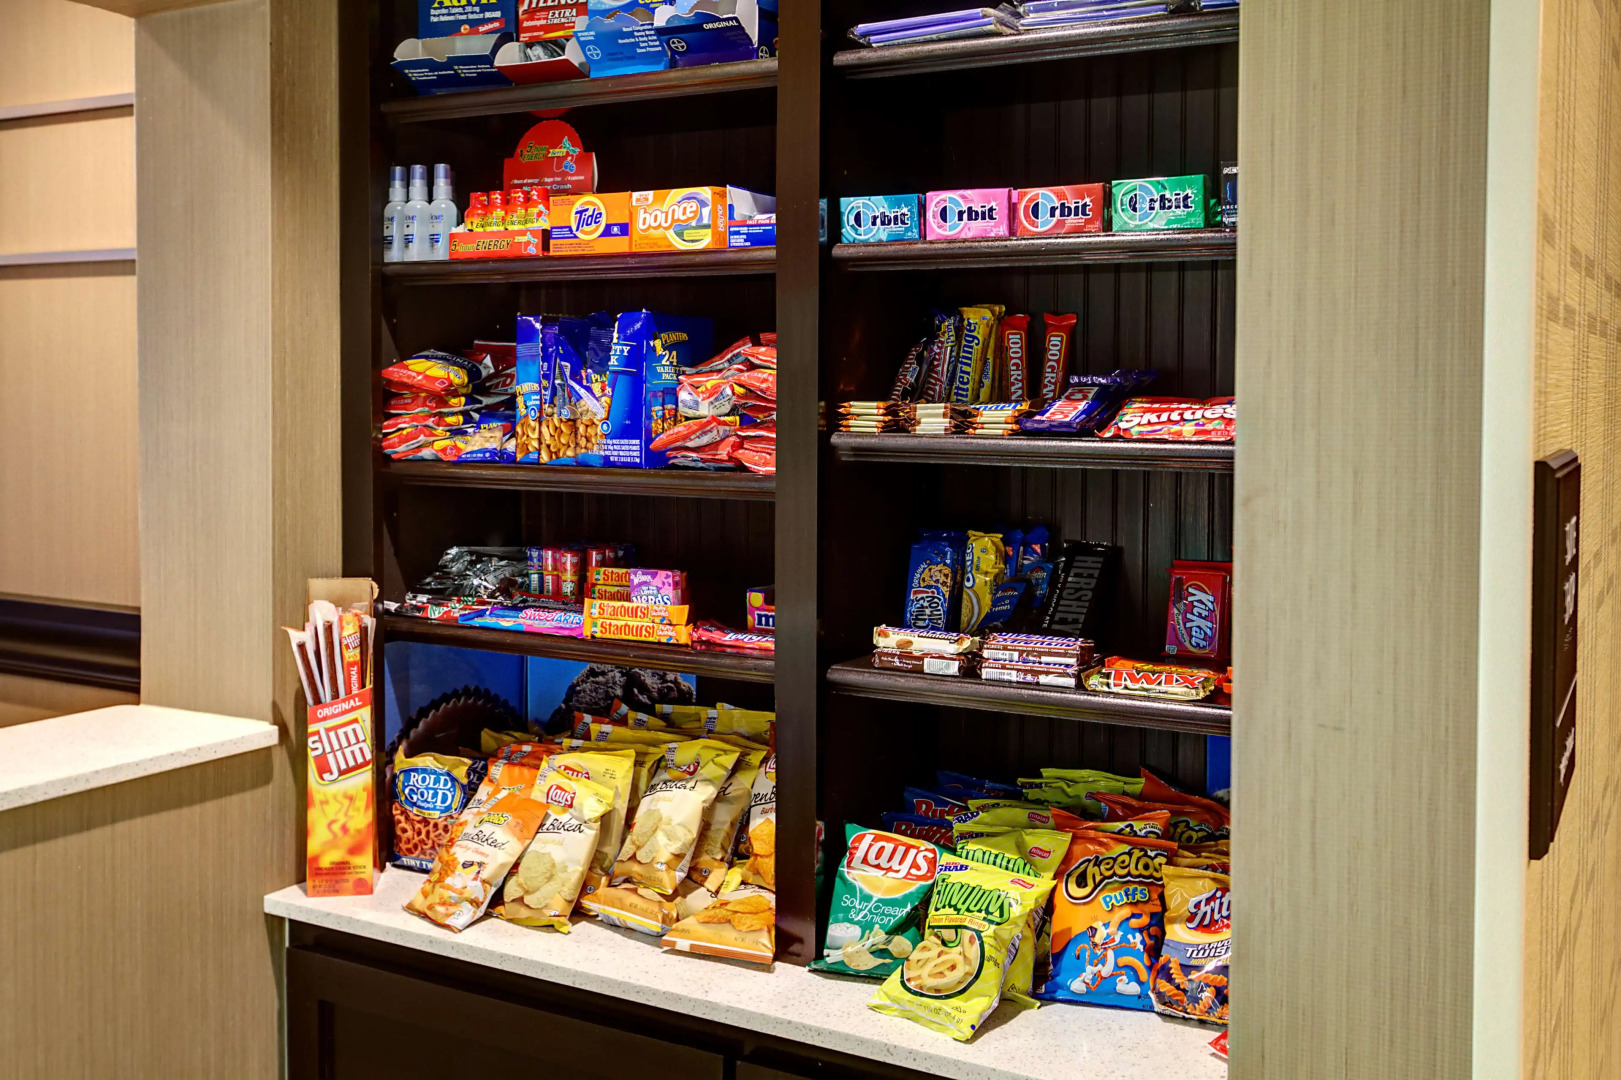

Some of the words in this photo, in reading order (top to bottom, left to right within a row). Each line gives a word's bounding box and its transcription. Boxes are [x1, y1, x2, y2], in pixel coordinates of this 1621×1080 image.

[548, 8, 576, 18] EXTRA
[478, 22, 500, 32] Tablets
[703, 20, 738, 30] ORIGINAL
[1025, 195, 1092, 226] Orbit
[1123, 187, 1194, 219] Orbit
[574, 207, 602, 232] Tide
[638, 202, 698, 231] bounce
[849, 204, 910, 234] Orbit
[934, 199, 998, 229] Orbit
[450, 240, 475, 252] 5-hour
[476, 239, 512, 250] ENERGY
[661, 332, 688, 344] PLANTERS
[1008, 334, 1022, 356] 100
[1048, 336, 1062, 360] 100
[428, 354, 472, 368] ORIGINAL
[662, 350, 677, 365] 24
[952, 317, 980, 402] tterfinger
[656, 366, 684, 374] VARIETY
[1009, 358, 1023, 401] GRAN
[1042, 360, 1058, 398] GRAN
[516, 383, 540, 396] PLANTERS
[1118, 405, 1236, 428] Skittles
[912, 562, 929, 588] ORIGINAL
[964, 543, 975, 589] OREO
[598, 603, 650, 619] Starburst
[910, 594, 930, 630] Chips
[600, 620, 655, 638] Starburst
[350, 664, 358, 695] RIGINAL
[317, 697, 363, 718] ORIGINAL
[410, 772, 452, 790] ROLD
[404, 786, 452, 806] GOLD
[546, 818, 585, 834] Baked
[851, 833, 934, 879] Lay's
[938, 864, 970, 874] GRAB
[1066, 848, 1168, 900] Cheetos
[842, 895, 868, 909] Sour
[1100, 886, 1150, 910] Puffs
[1186, 887, 1231, 930] Frit
[848, 908, 858, 918] &
[859, 912, 894, 925] Onion
[930, 916, 944, 924] Onion
[944, 916, 968, 925] Flavored
[968, 918, 986, 930] Rings
[1198, 940, 1231, 951] FLAVO
